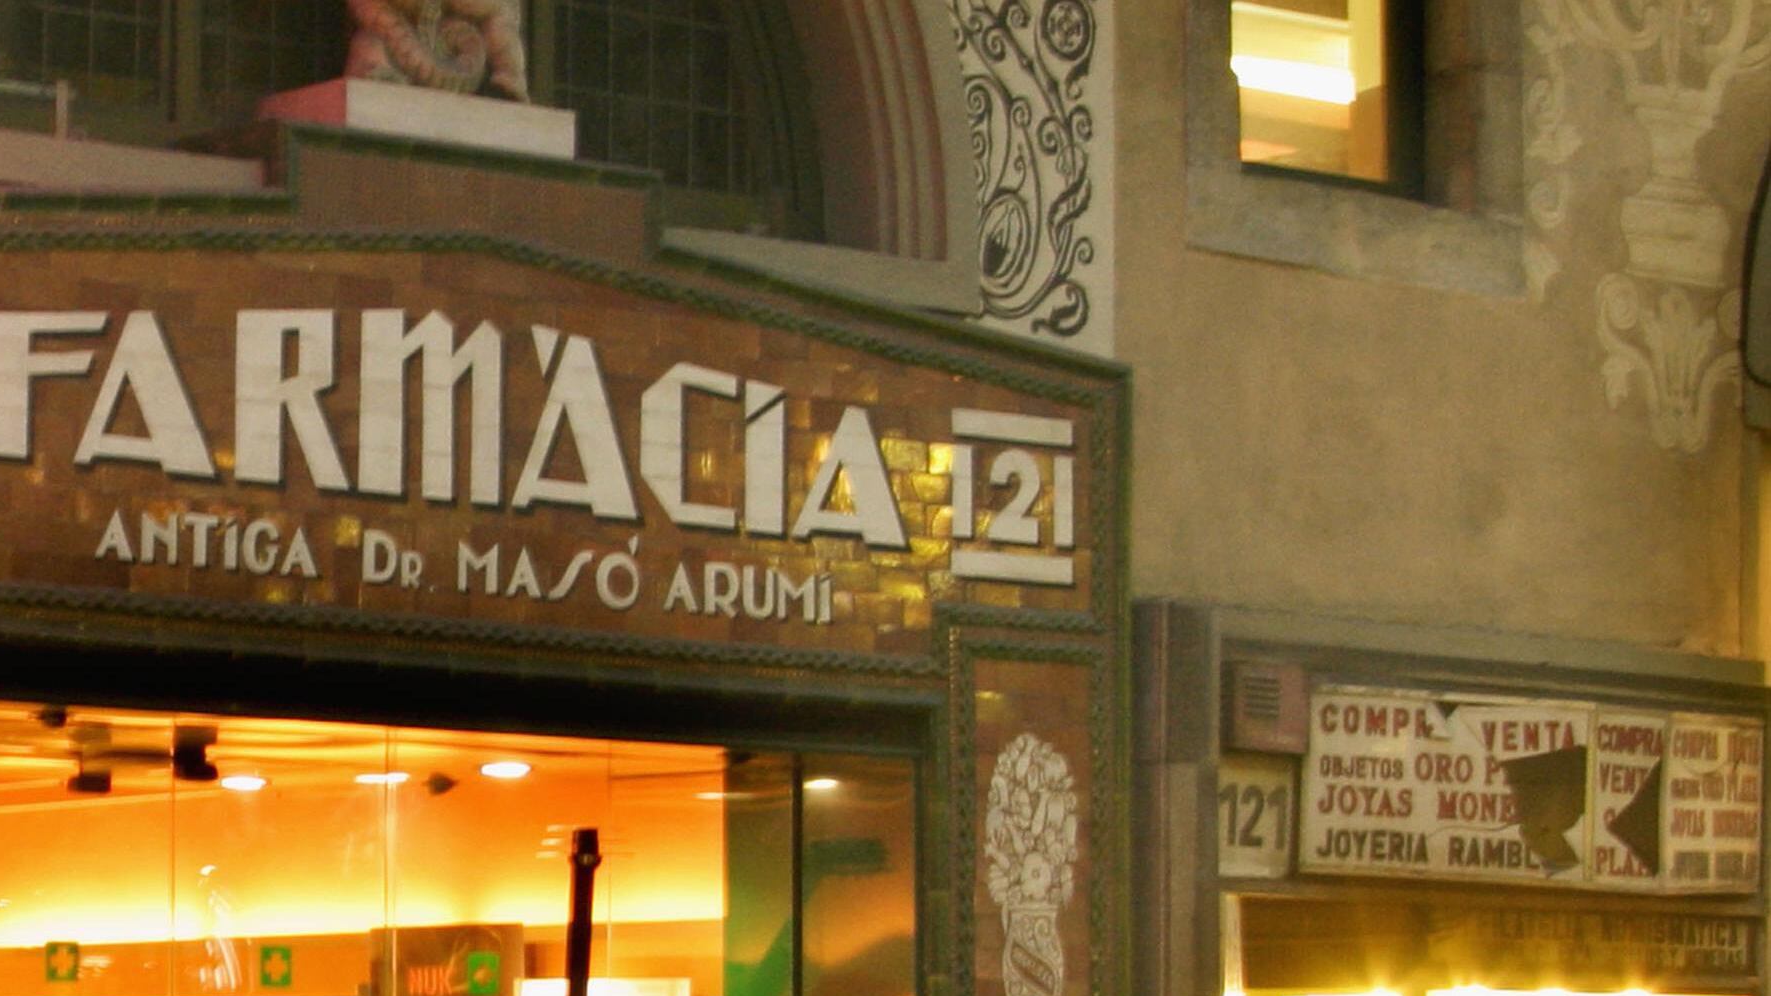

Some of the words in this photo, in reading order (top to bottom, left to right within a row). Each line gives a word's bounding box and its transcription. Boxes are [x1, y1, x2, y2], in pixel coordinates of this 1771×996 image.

[457, 535, 640, 611] MASÓ
[1320, 704, 1435, 738] COMPR
[1481, 720, 1575, 752] VENTA
[1597, 724, 1663, 755] COMPRA
[1319, 755, 1404, 780] OBJETOS
[1414, 752, 1474, 784] ORO
[1599, 762, 1650, 794] VENT
[1219, 782, 1287, 851] 121
[1317, 784, 1413, 818] JOYAS
[1437, 790, 1524, 823] MONE
[1316, 828, 1429, 863] JOYERIA
[1448, 836, 1541, 870] RAMBL
[1595, 846, 1648, 876] PLA
[409, 967, 453, 996] NUK
